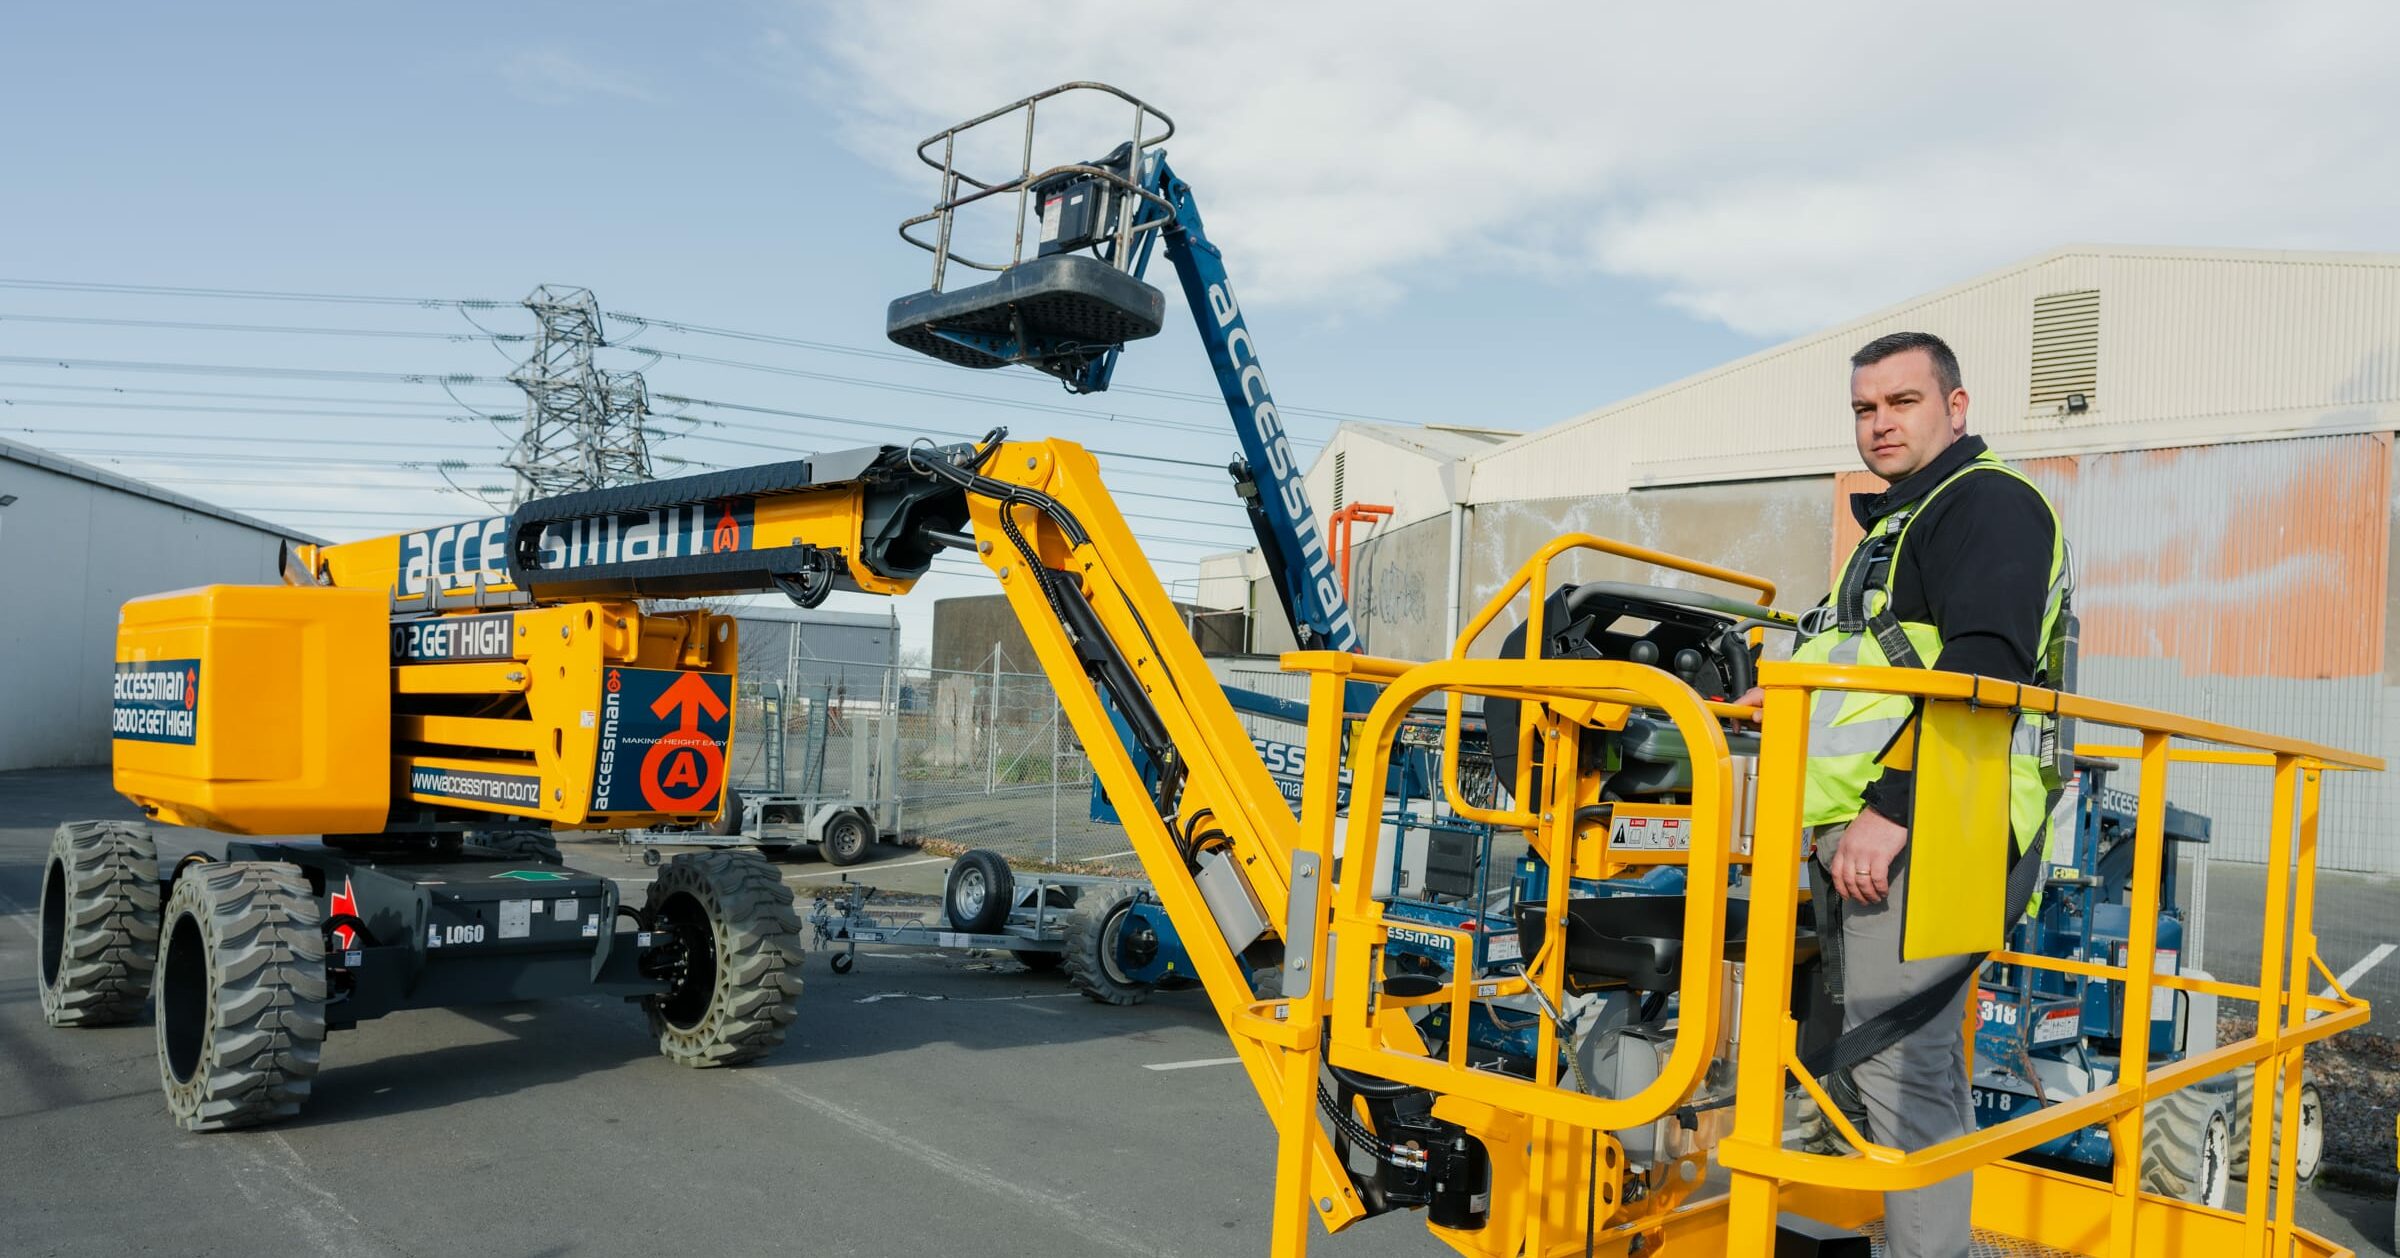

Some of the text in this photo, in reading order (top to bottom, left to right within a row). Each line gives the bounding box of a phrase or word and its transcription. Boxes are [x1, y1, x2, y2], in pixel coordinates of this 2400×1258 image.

[1209, 278, 1357, 652] accessman
[406, 504, 705, 594] accesman
[422, 622, 459, 657] GET
[461, 619, 509, 656] HIGH
[114, 671, 184, 700] accessman
[113, 708, 193, 737] 0800 2 GET HIGH
[595, 692, 620, 810] accessman
[622, 737, 663, 745] MAKING
[662, 751, 700, 788] A
[411, 772, 539, 802] www.accessman.co.nz
[2102, 788, 2139, 815] access
[1387, 926, 1450, 949] essman
[1981, 1001, 2017, 1025] 318
[1973, 1089, 2012, 1111] 318
